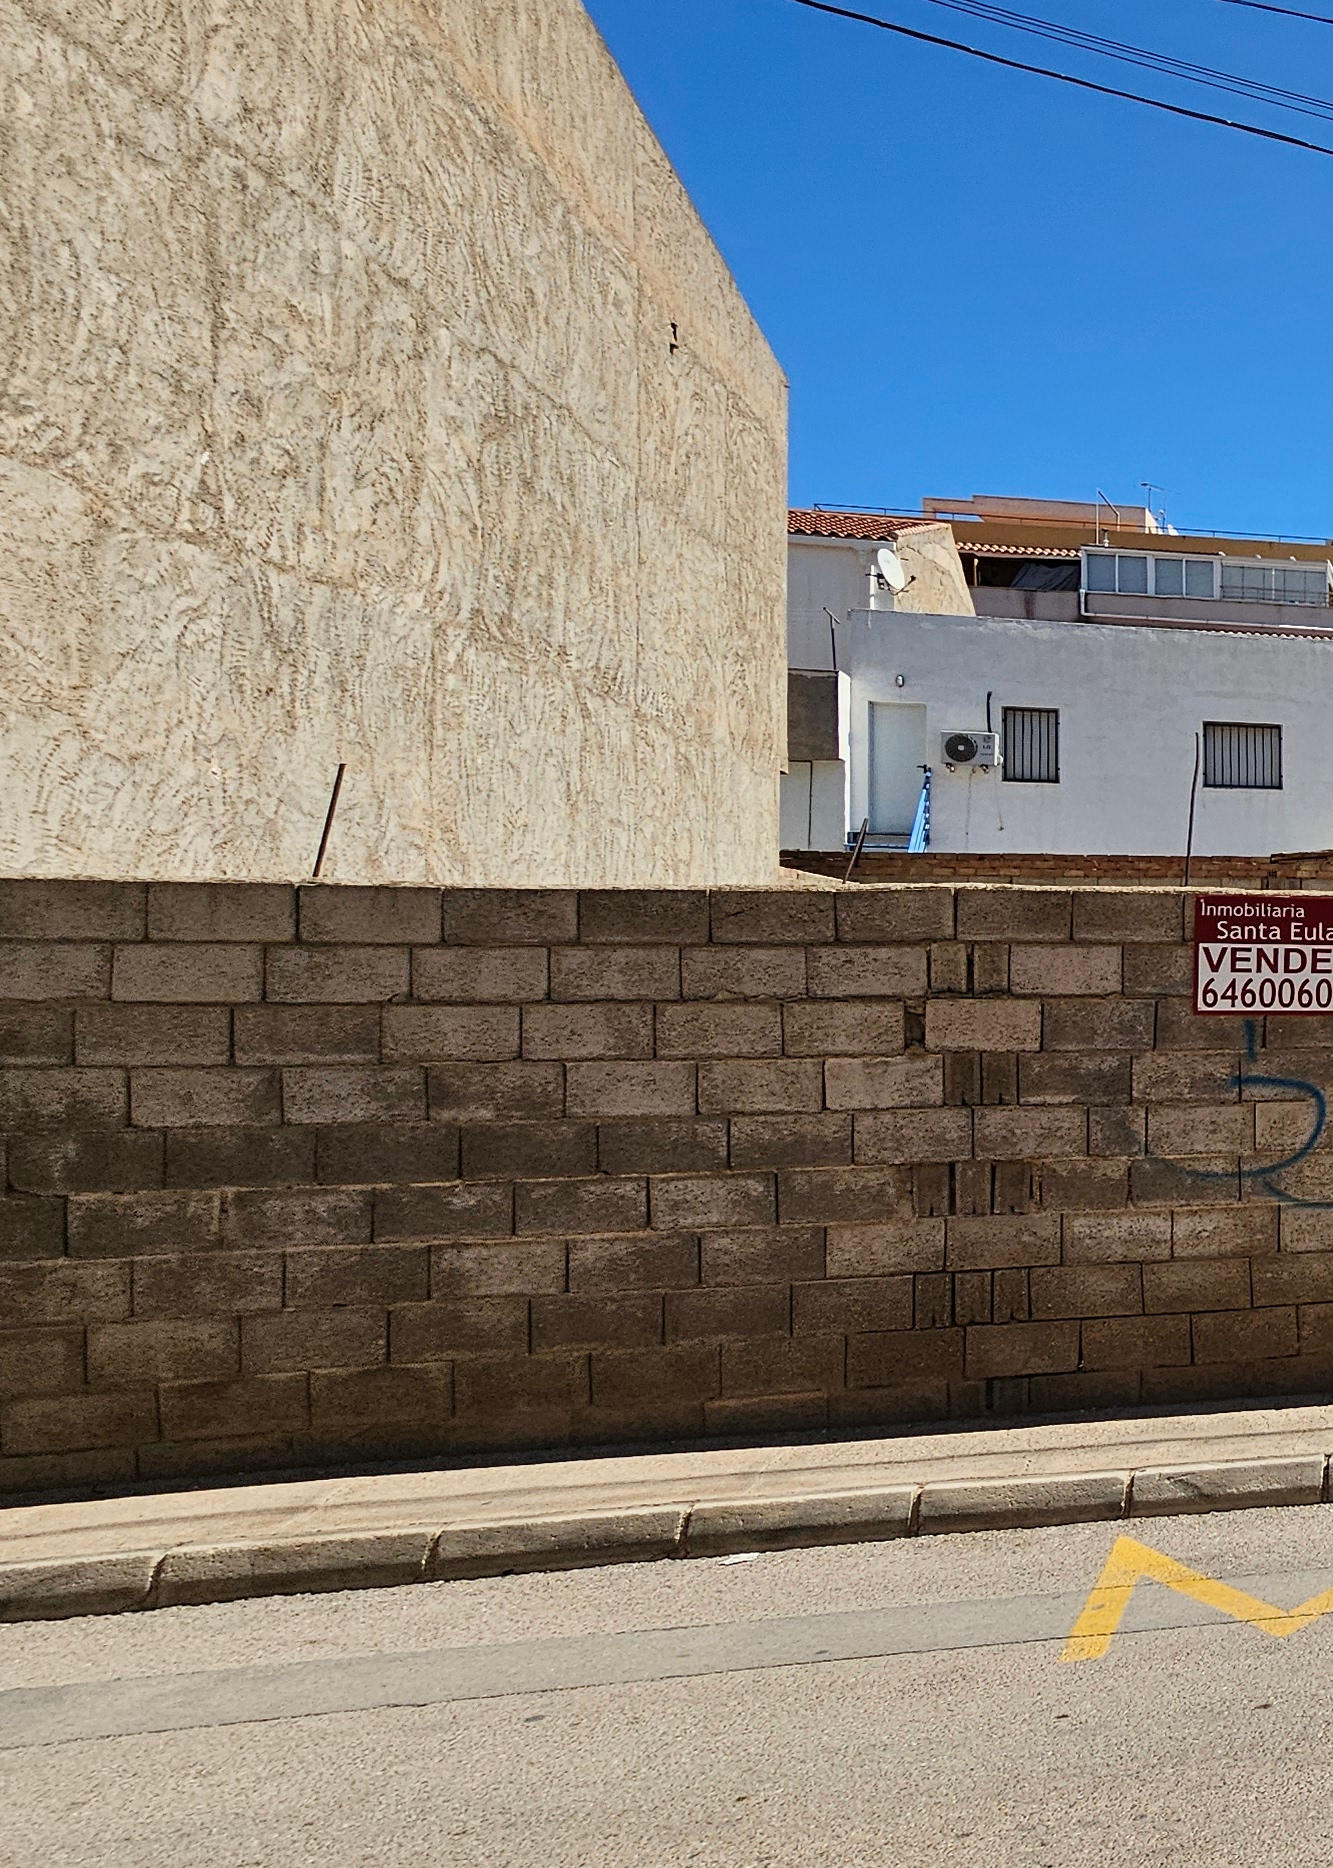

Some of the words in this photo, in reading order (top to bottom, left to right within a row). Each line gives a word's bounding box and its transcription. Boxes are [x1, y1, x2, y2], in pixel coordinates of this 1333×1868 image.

[1201, 901, 1305, 919] Inmobiliaria
[1217, 921, 1282, 940] Santa
[1202, 946, 1333, 974] VENDE
